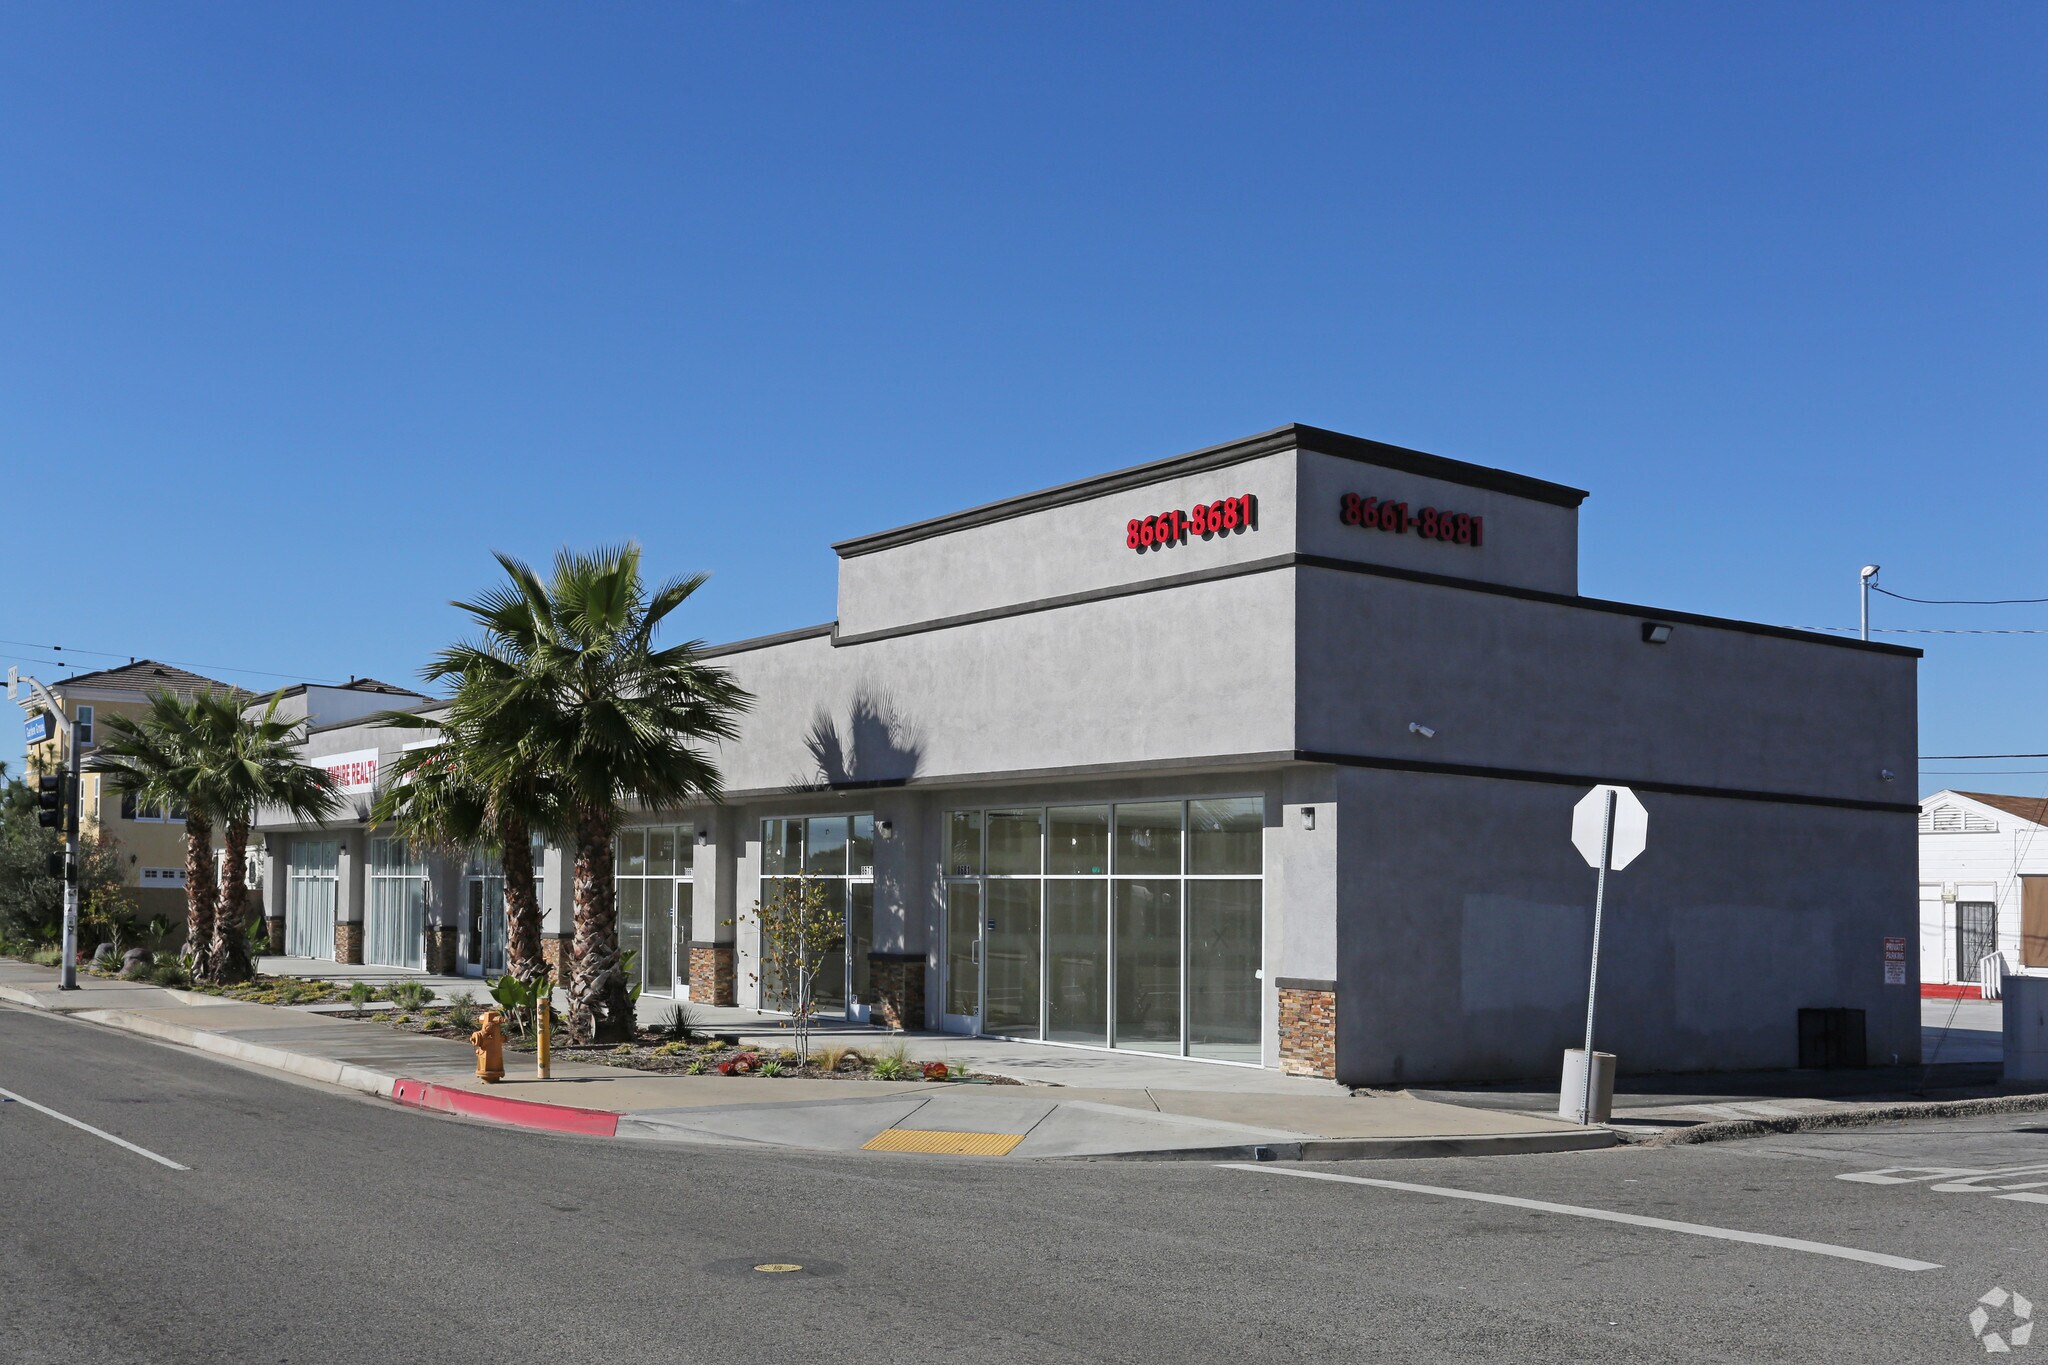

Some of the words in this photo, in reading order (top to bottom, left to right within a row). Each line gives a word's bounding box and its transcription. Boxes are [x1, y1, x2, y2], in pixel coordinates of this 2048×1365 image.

[1127, 494, 1250, 549] 8661-8681
[1342, 492, 1483, 546] 8661-8681
[352, 760, 377, 785] REALTY
[1886, 943, 1904, 951] PRIVATE
